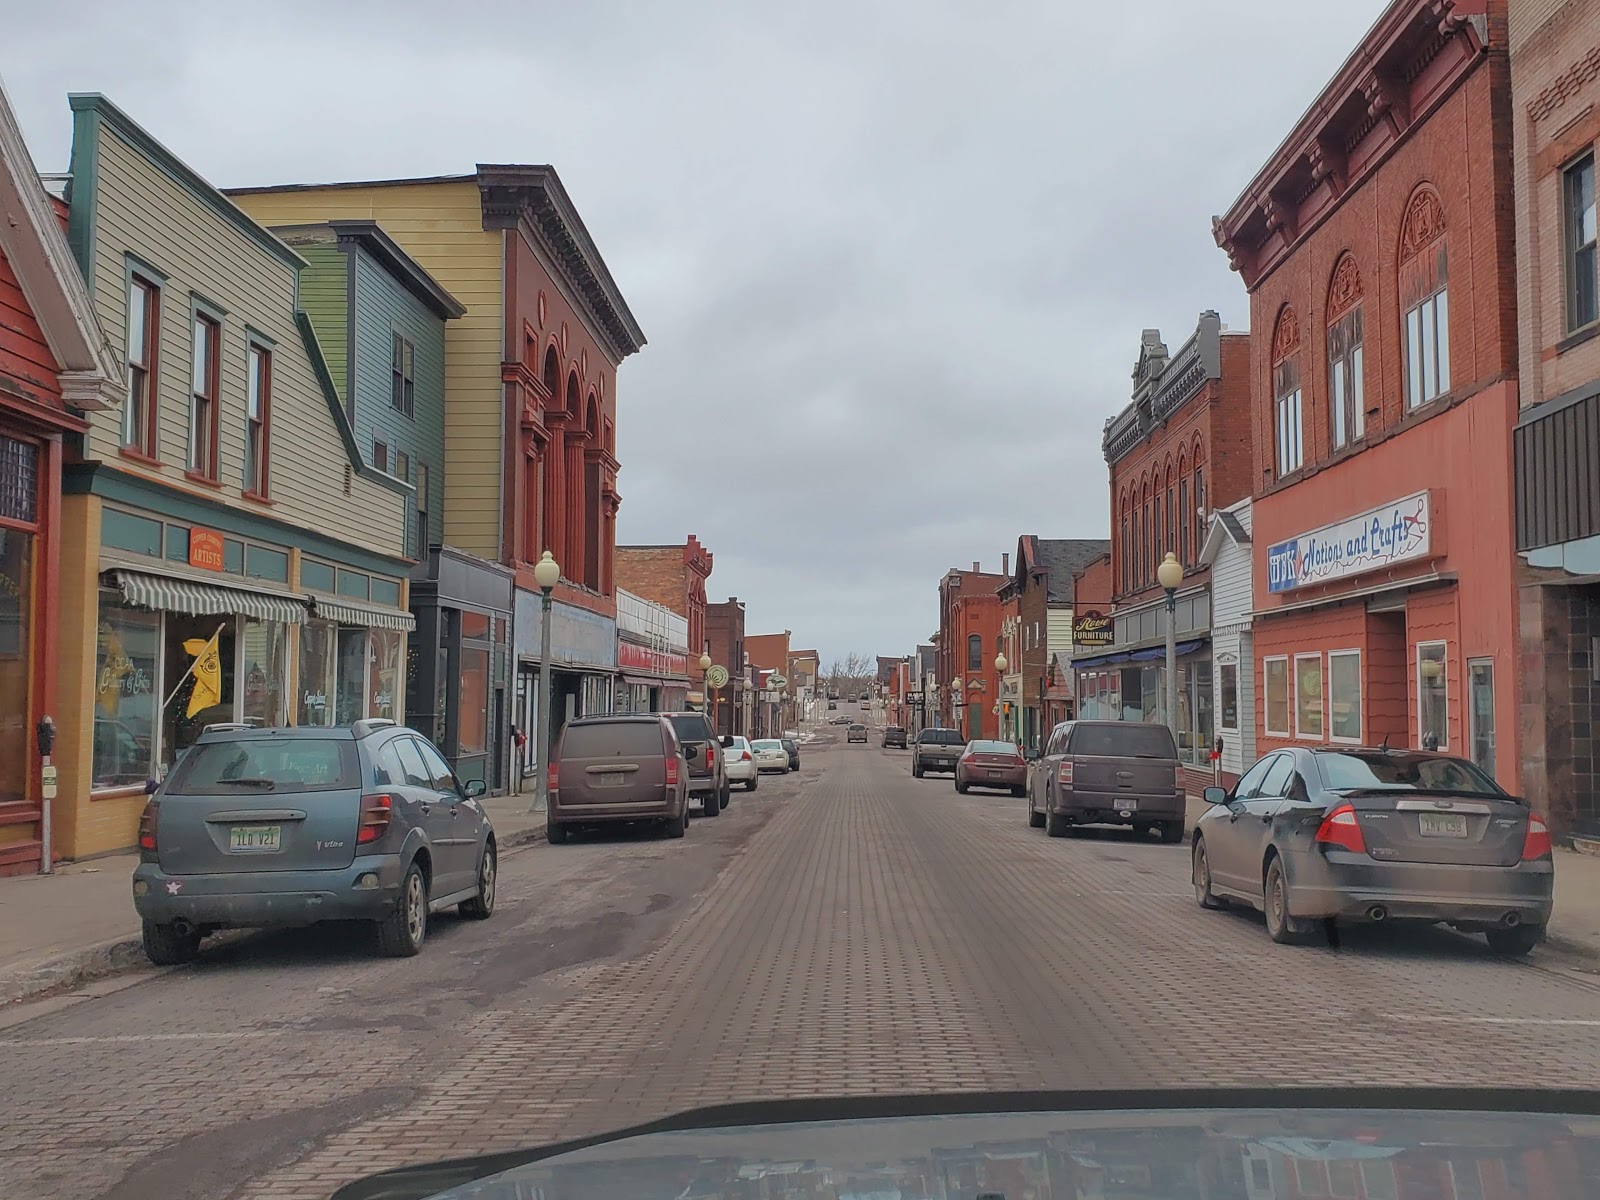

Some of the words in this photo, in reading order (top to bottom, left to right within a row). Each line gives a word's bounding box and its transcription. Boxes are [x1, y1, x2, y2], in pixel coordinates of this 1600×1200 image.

[1303, 538, 1343, 576] Notions
[1347, 521, 1367, 557] and
[1371, 510, 1410, 555] Crafts
[193, 548, 221, 566] ARTISTS
[1073, 631, 1114, 640] FURNITURE
[259, 833, 275, 845] V21
